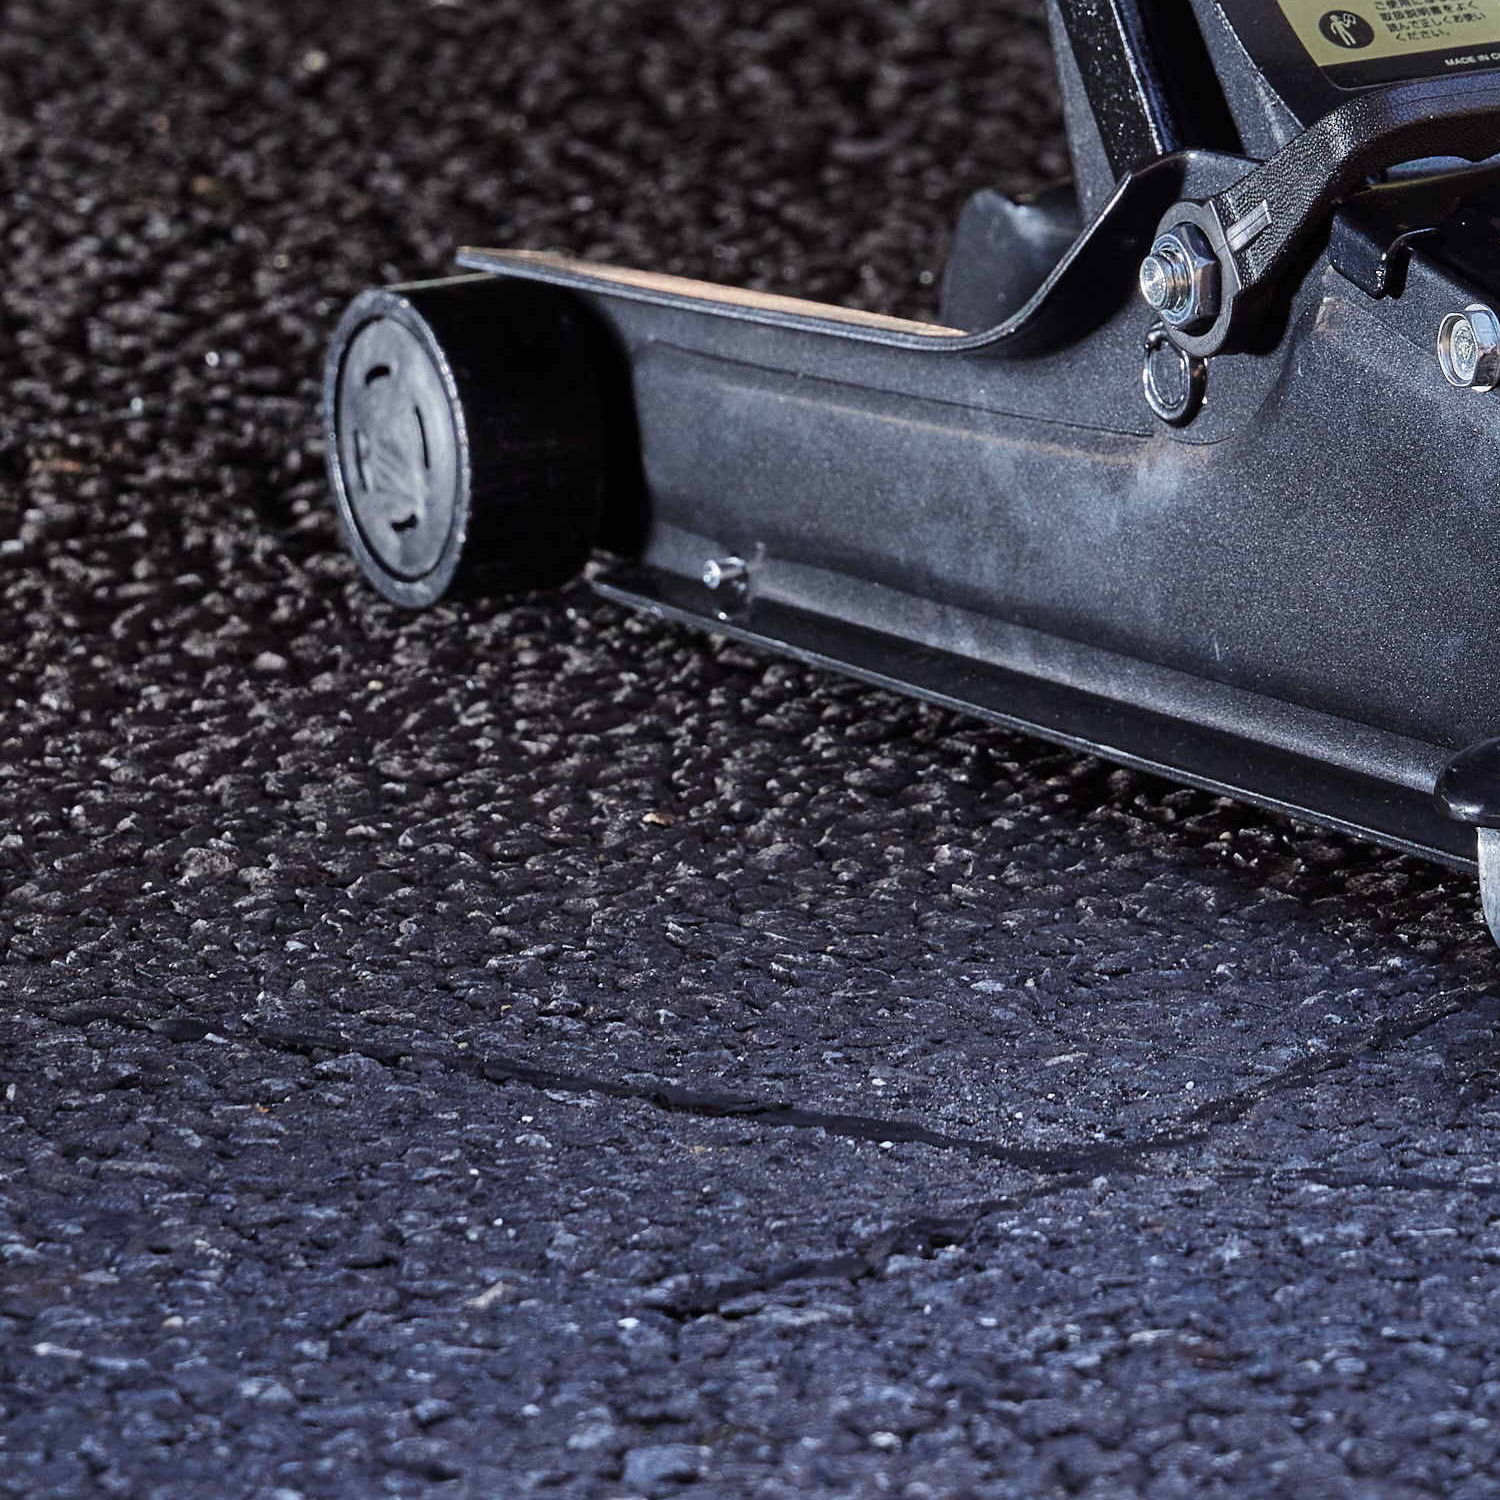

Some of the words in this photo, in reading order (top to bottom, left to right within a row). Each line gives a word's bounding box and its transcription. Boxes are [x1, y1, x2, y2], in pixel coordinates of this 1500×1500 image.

[1379, 1, 1478, 22] 取扱説明書をよく
[1386, 12, 1486, 33] 読んで正しくお使い
[1396, 29, 1450, 42] ください。
[1444, 55, 1477, 67] MADE
[1477, 53, 1490, 63] IN
